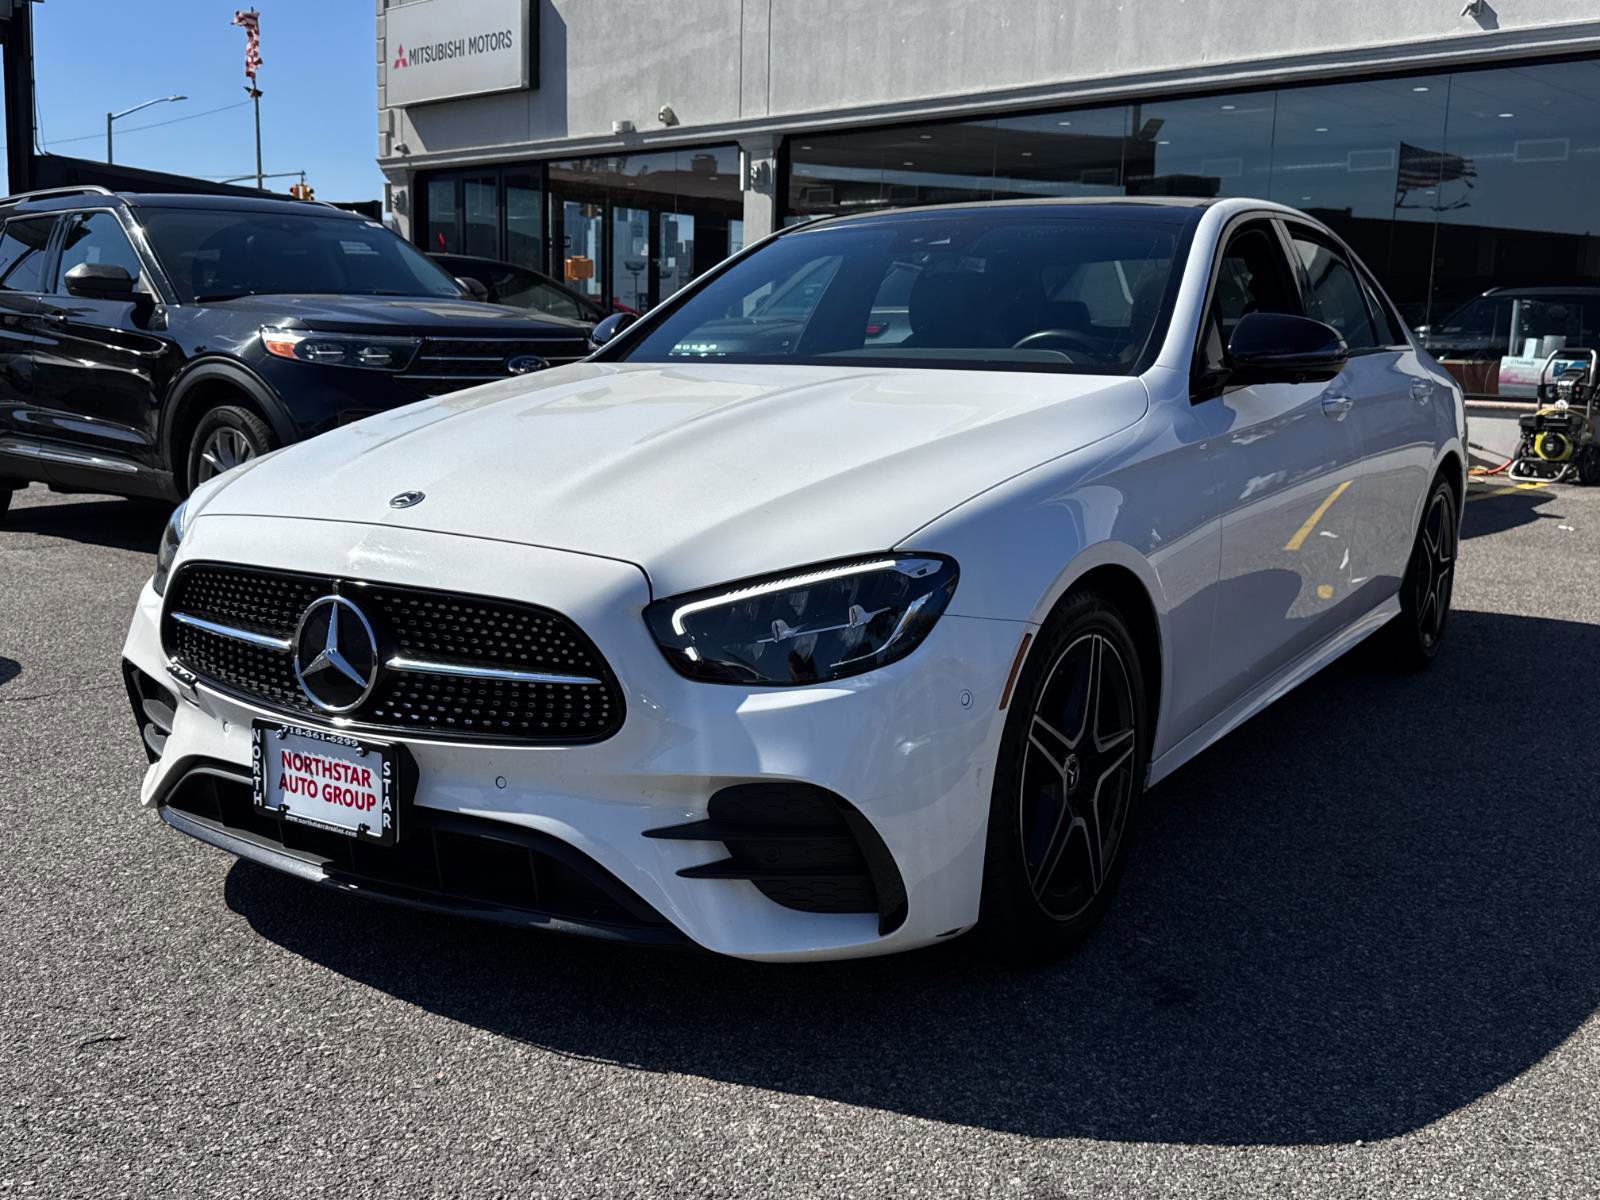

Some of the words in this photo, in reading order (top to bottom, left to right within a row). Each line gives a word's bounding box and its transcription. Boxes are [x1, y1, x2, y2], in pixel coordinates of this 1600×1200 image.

[409, 39, 465, 66] MITSUBISHI
[469, 30, 512, 55] MOTORS
[282, 725, 358, 747] 718-361-6299
[252, 728, 262, 806] NORTH
[281, 751, 372, 789] NORTHSTAR
[279, 773, 318, 798] AUTO
[322, 784, 376, 811] GROUP
[383, 761, 392, 828] STAR
